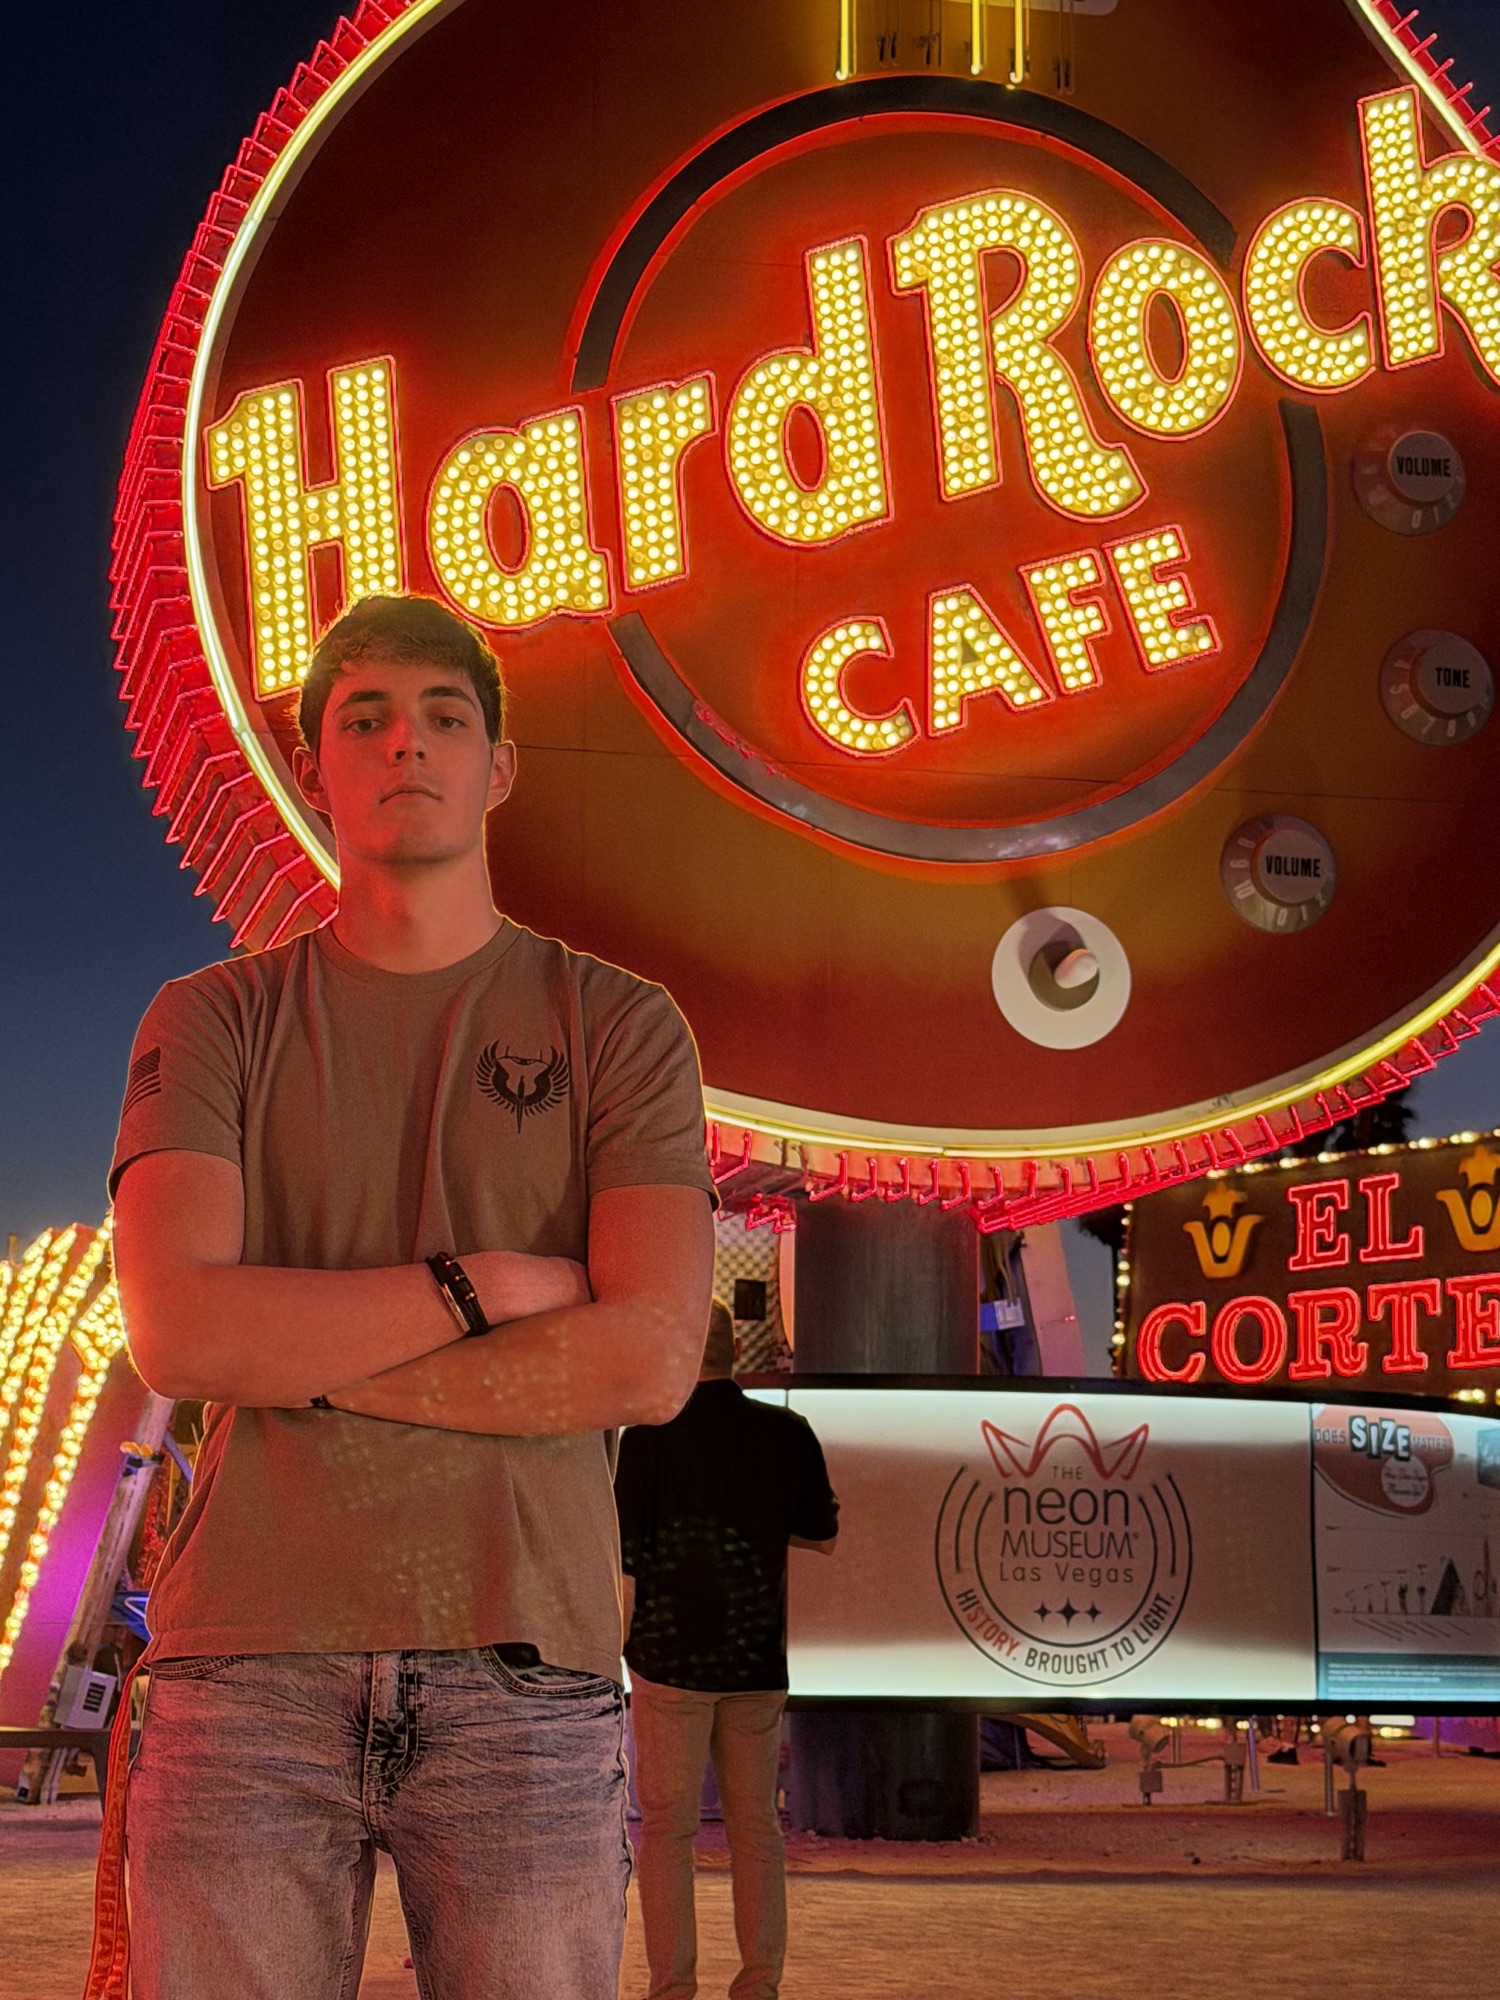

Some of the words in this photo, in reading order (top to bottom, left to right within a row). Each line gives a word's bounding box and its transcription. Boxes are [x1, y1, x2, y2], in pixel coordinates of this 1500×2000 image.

[203, 234, 894, 702] Hard
[886, 85, 1500, 523] Rock
[1396, 456, 1451, 477] VOLUME
[800, 524, 1222, 759] CAFE
[1435, 667, 1470, 688] TONE
[1266, 855, 1321, 878] VOLUME
[1286, 1172, 1424, 1272] EL
[1314, 1428, 1346, 1444] DOES
[1349, 1415, 1411, 1461] SIZE
[1052, 1465, 1083, 1480] THE
[1003, 1486, 1130, 1526] neon
[1000, 1562, 1041, 1582] Las
[1055, 1563, 1134, 1588] Vegas
[1024, 1647, 1109, 1675] BROUGHT
[1110, 1636, 1136, 1662] TO
[1132, 1592, 1175, 1644] LIGHT.
